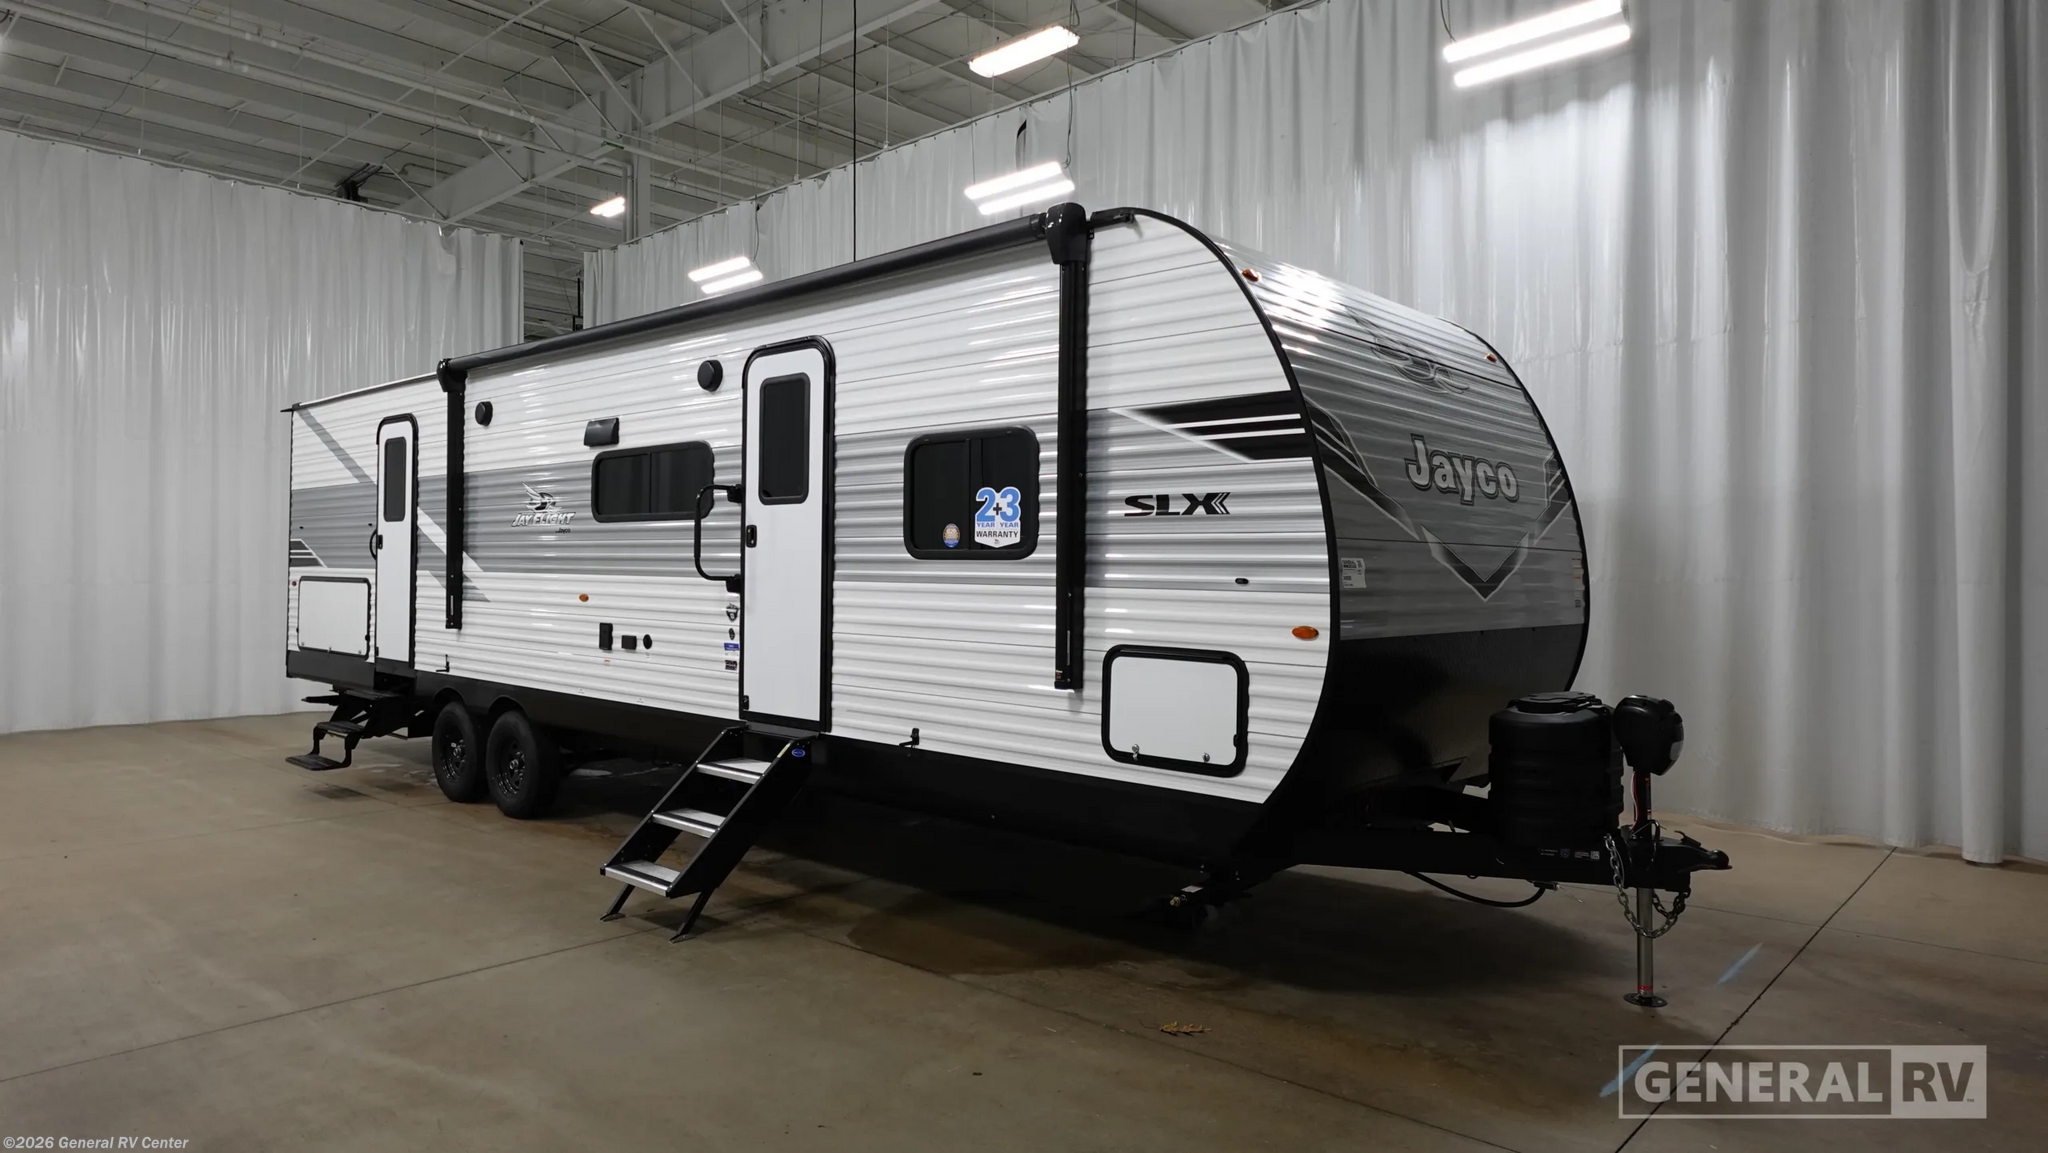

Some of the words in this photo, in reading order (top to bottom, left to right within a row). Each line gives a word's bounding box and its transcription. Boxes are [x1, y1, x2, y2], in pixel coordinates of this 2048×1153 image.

[1403, 433, 1520, 506] Jayco
[1125, 492, 1230, 517] SLX
[511, 512, 533, 527] JAY
[533, 511, 576, 527] FLIGHT
[976, 530, 1019, 538] WARRANTY
